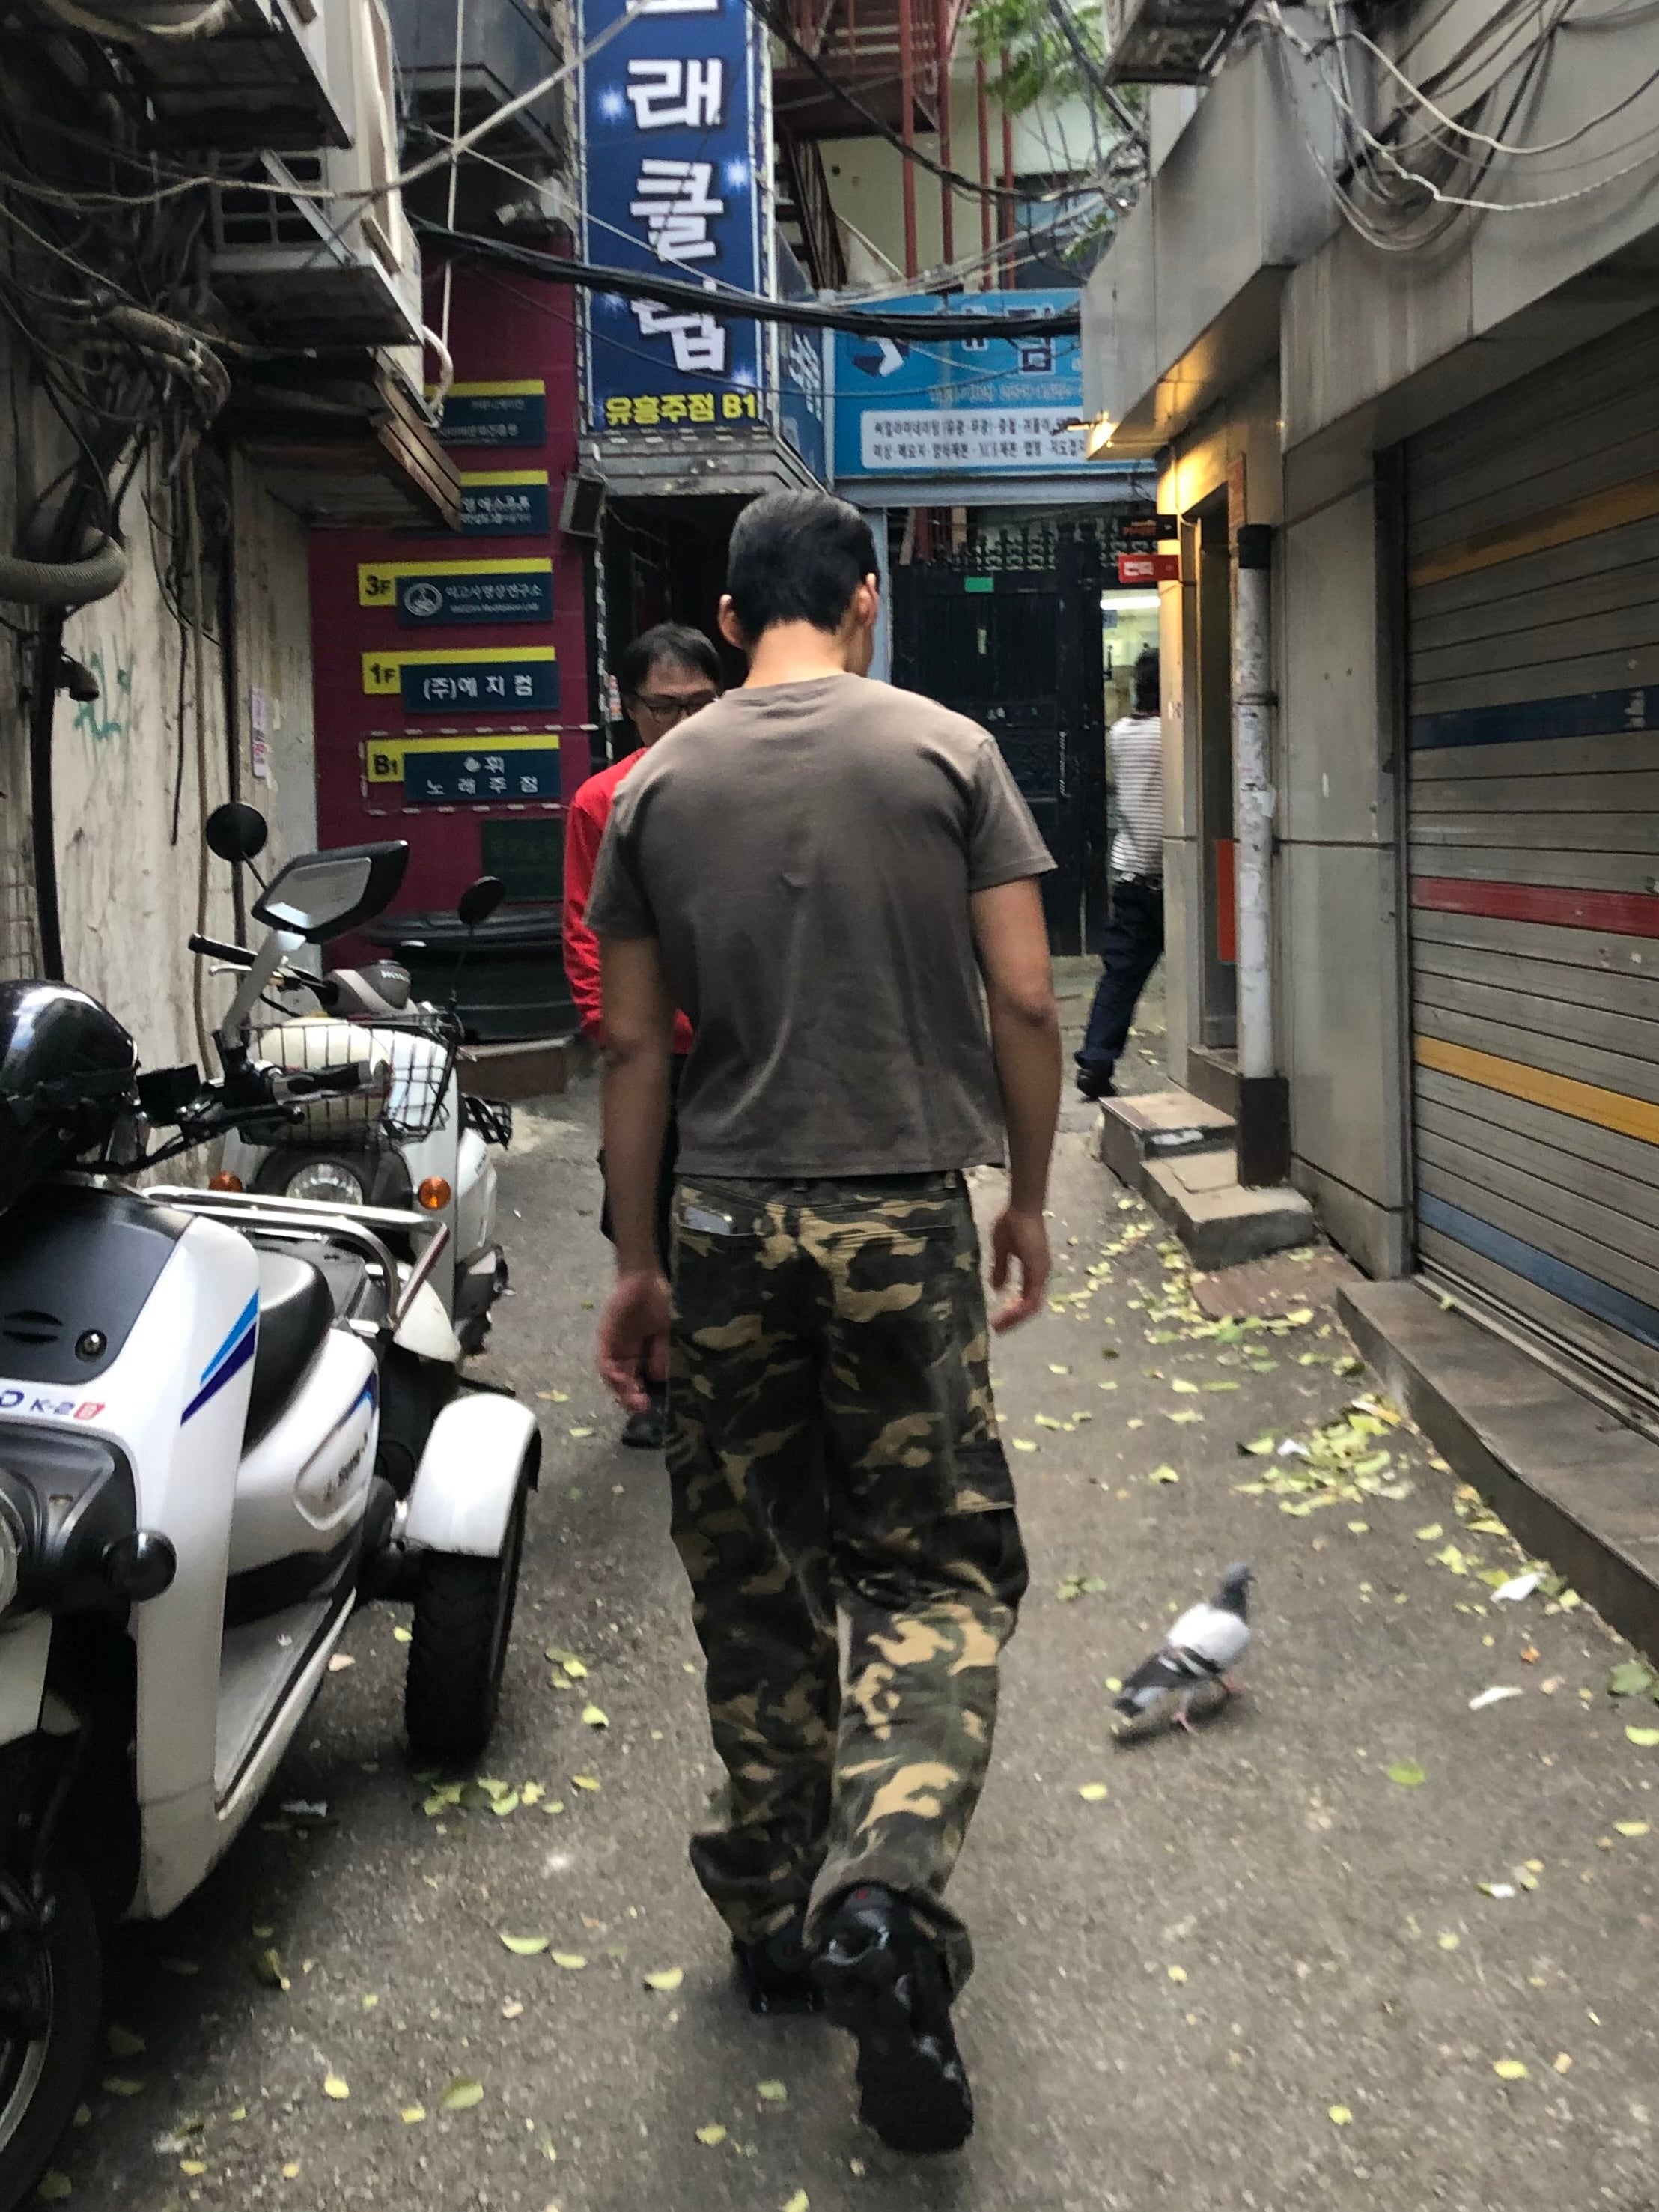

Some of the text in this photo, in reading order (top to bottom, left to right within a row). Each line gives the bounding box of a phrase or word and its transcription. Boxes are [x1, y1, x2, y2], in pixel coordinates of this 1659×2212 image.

[626, 0, 725, 372] 래클럽
[606, 392, 757, 426] 유흥주점 B1
[365, 574, 391, 596] 3F
[370, 662, 395, 684] 1F
[373, 753, 398, 775] B1
